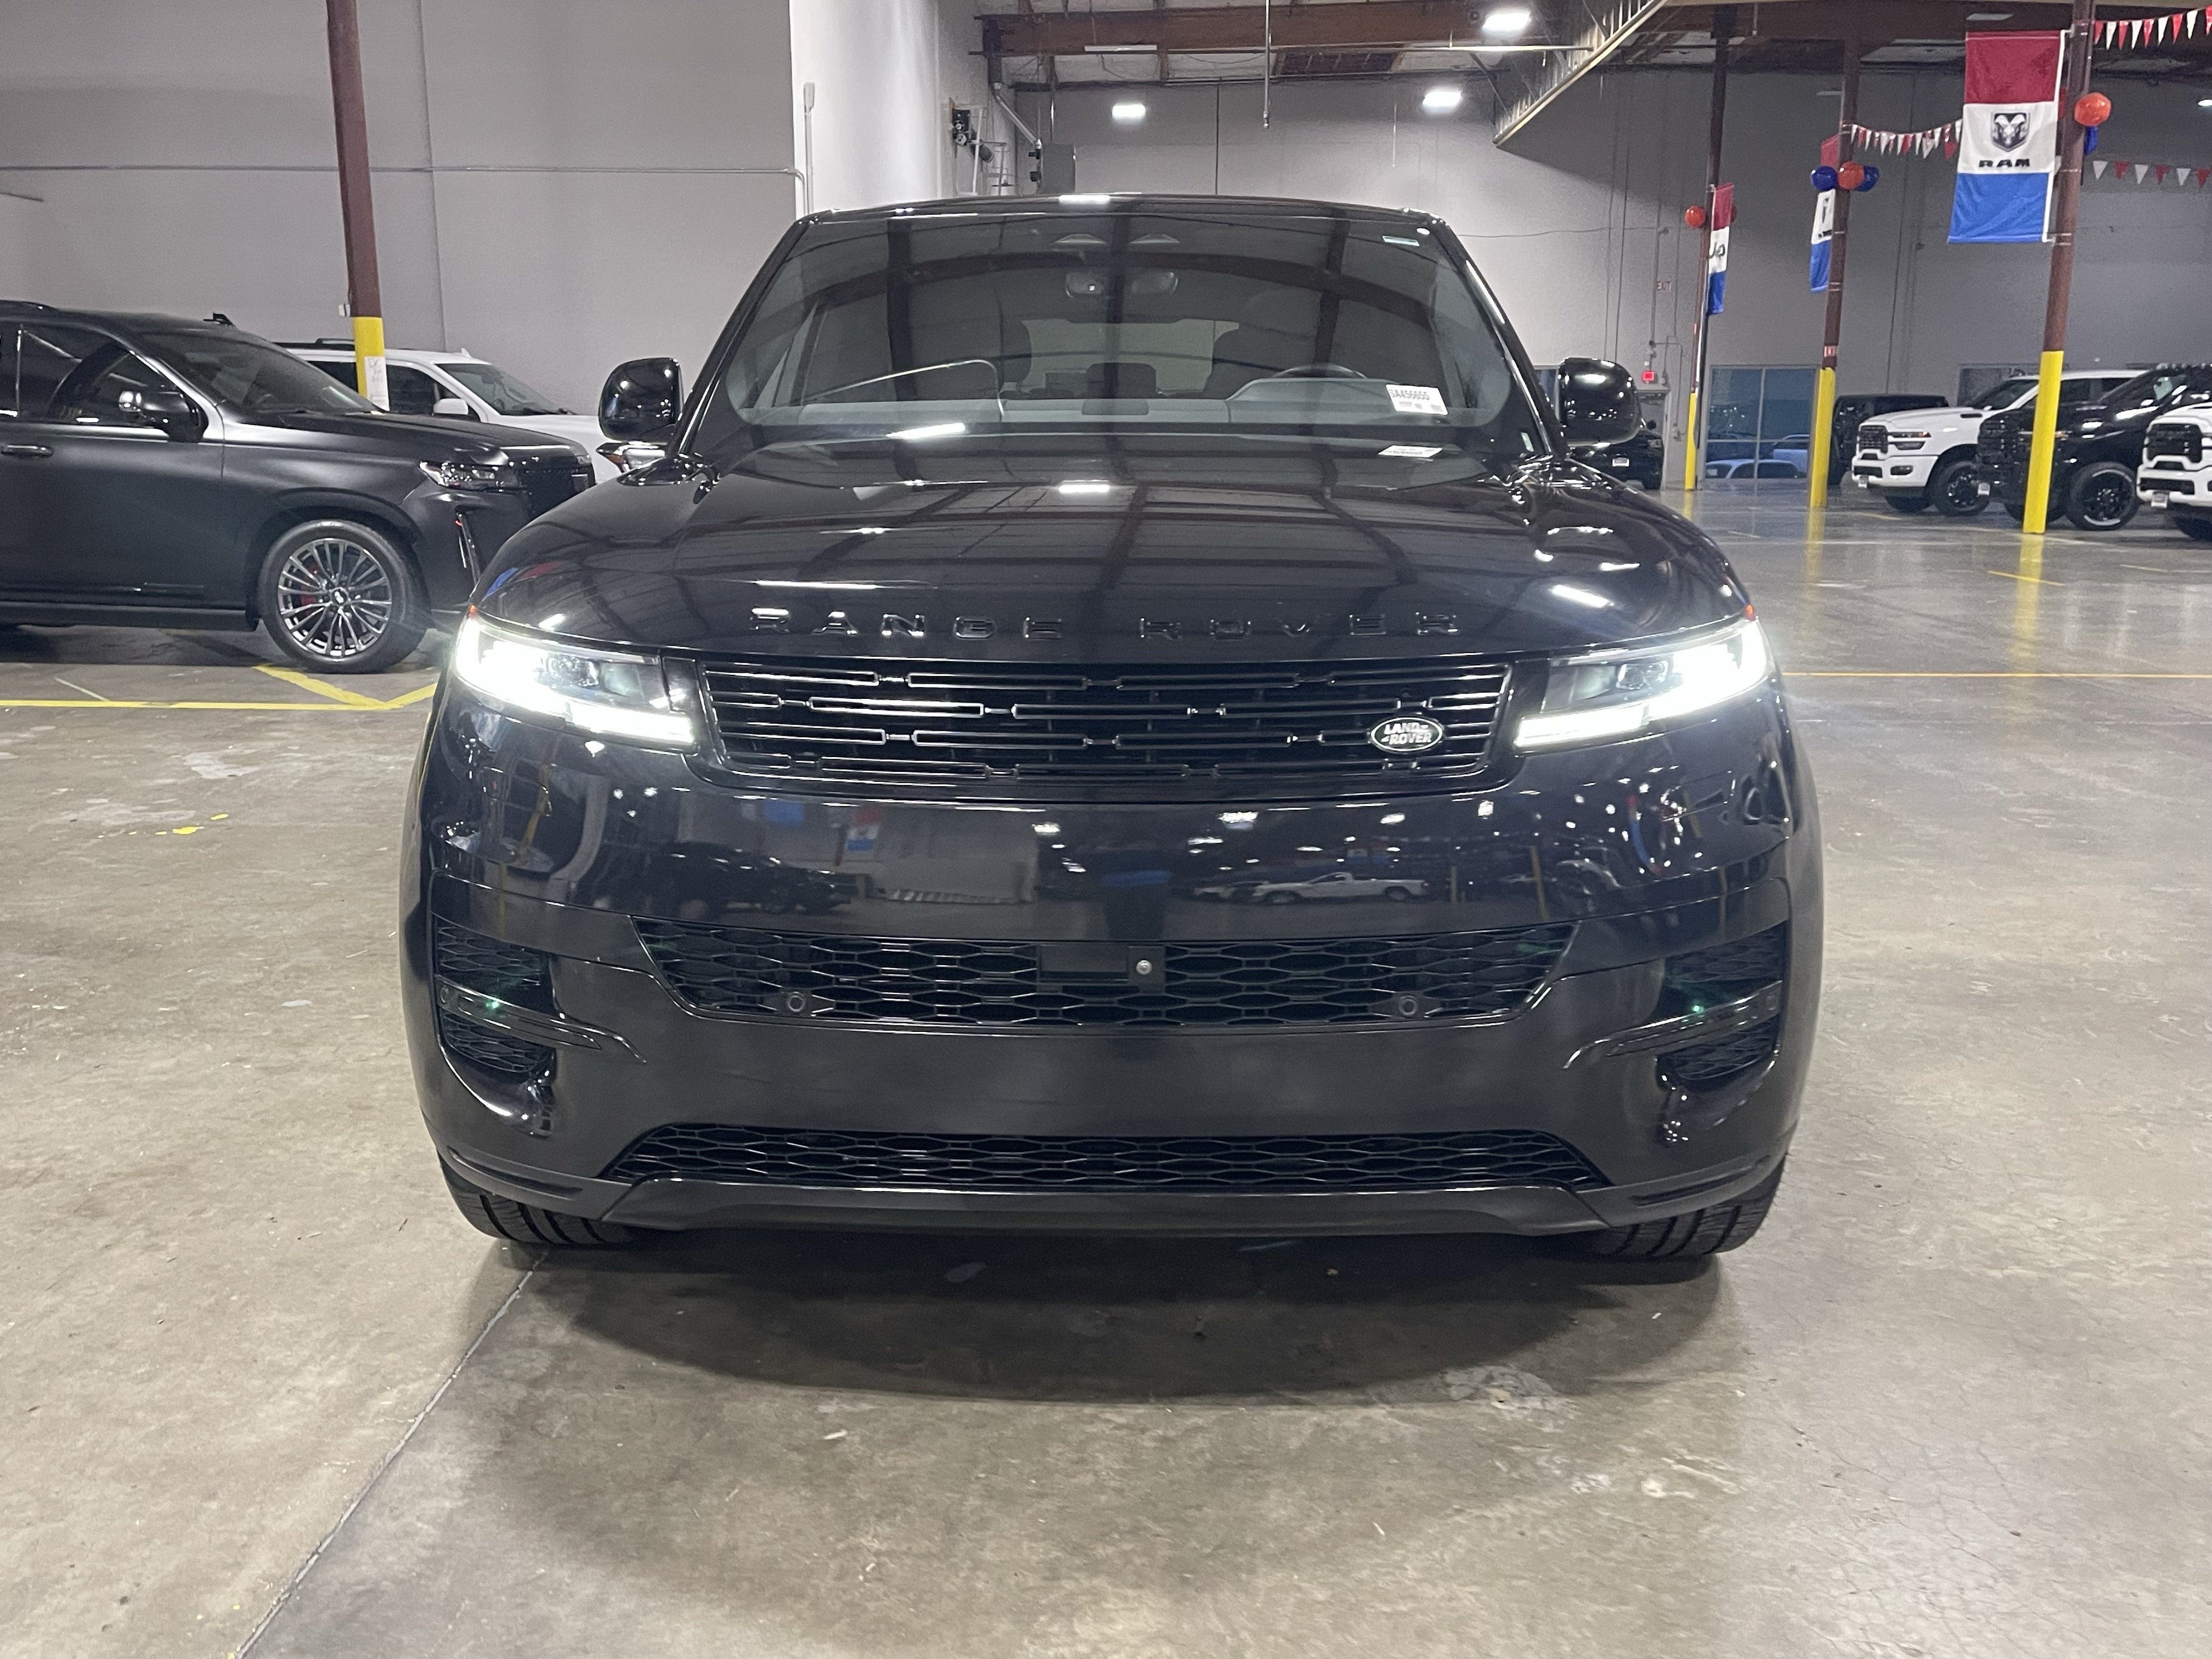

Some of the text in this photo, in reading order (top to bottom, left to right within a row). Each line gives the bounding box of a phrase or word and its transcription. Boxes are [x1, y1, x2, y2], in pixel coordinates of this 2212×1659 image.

[1978, 158, 2030, 168] RAM
[749, 607, 1460, 640] RANGE ROVER
[1384, 722, 1419, 735] LAND
[1389, 732, 1432, 745] ROVER
